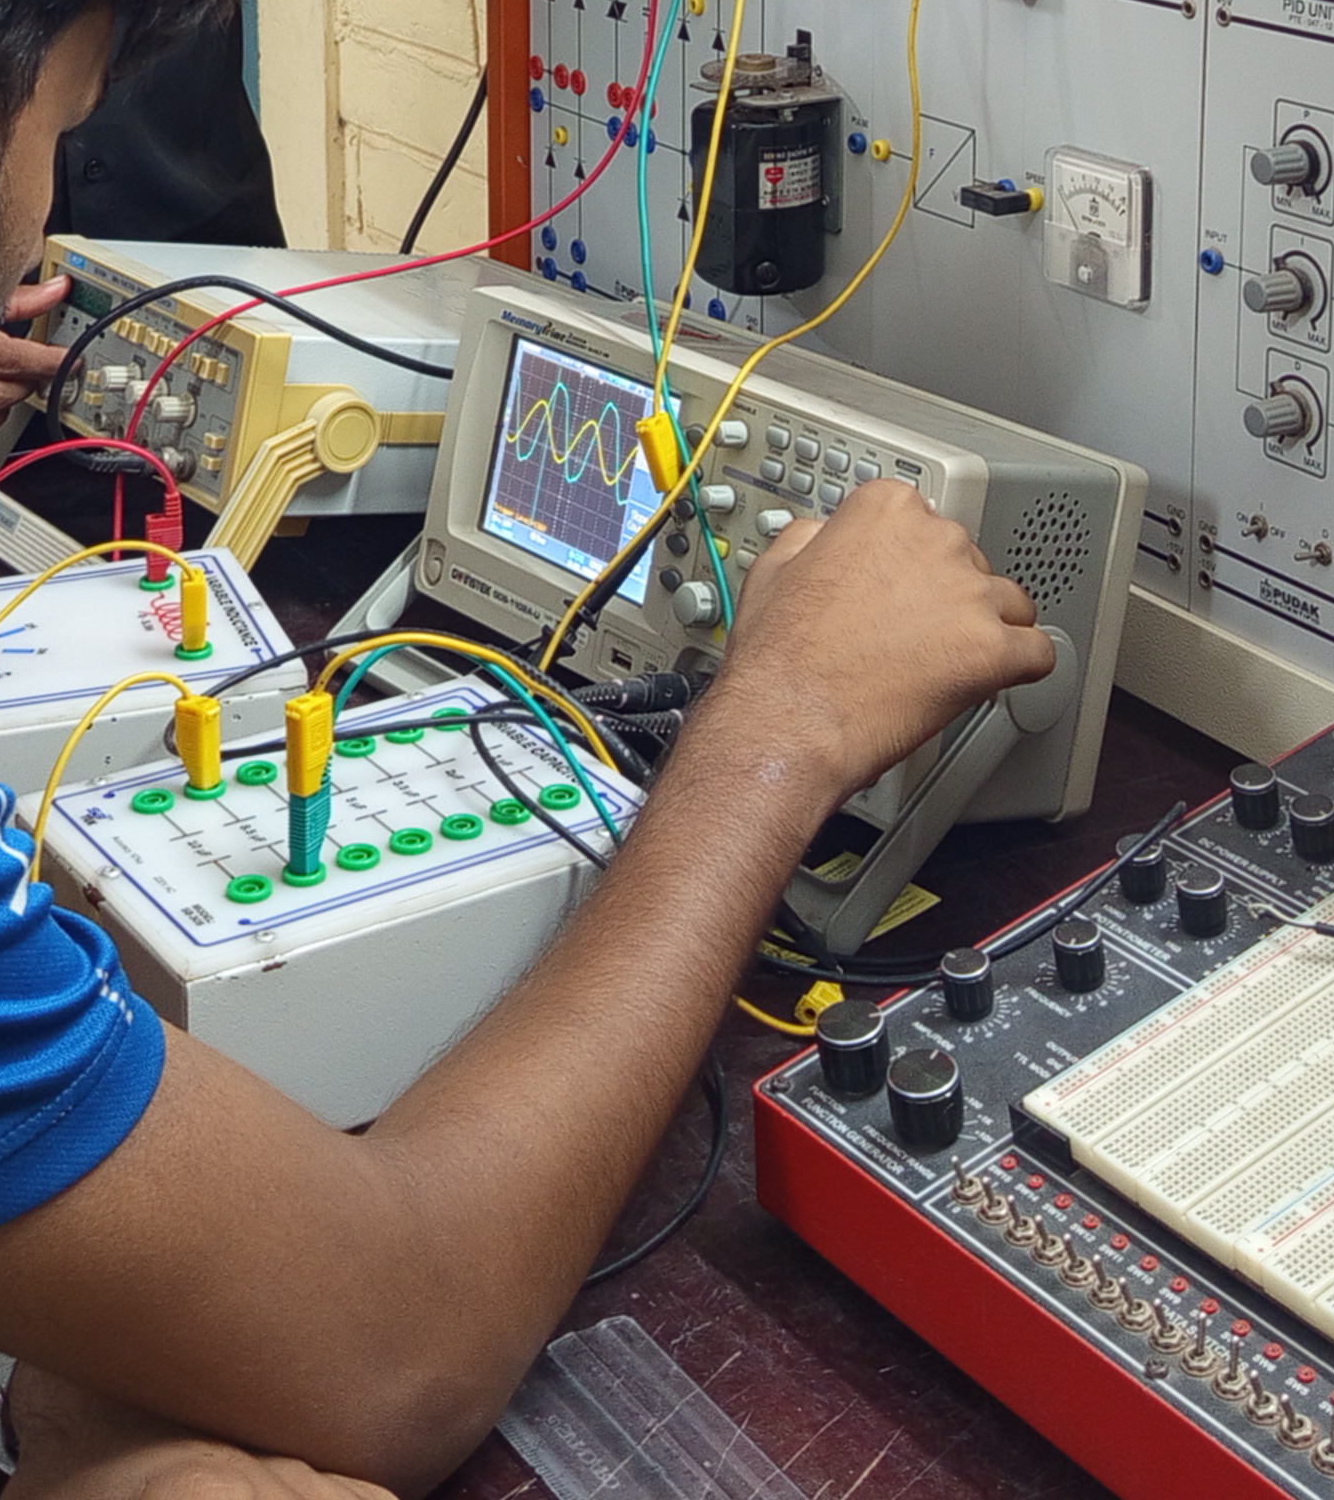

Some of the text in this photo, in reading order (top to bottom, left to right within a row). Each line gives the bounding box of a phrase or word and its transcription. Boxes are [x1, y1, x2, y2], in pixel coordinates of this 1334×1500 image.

[1273, 586, 1320, 619] PUDAK
[1091, 912, 1172, 961] POTENTIOMETER
[808, 1085, 847, 1114] FUNCTION
[801, 1097, 905, 1176] FUNCTION GENERATOR
[906, 1158, 937, 1181] RANGE
